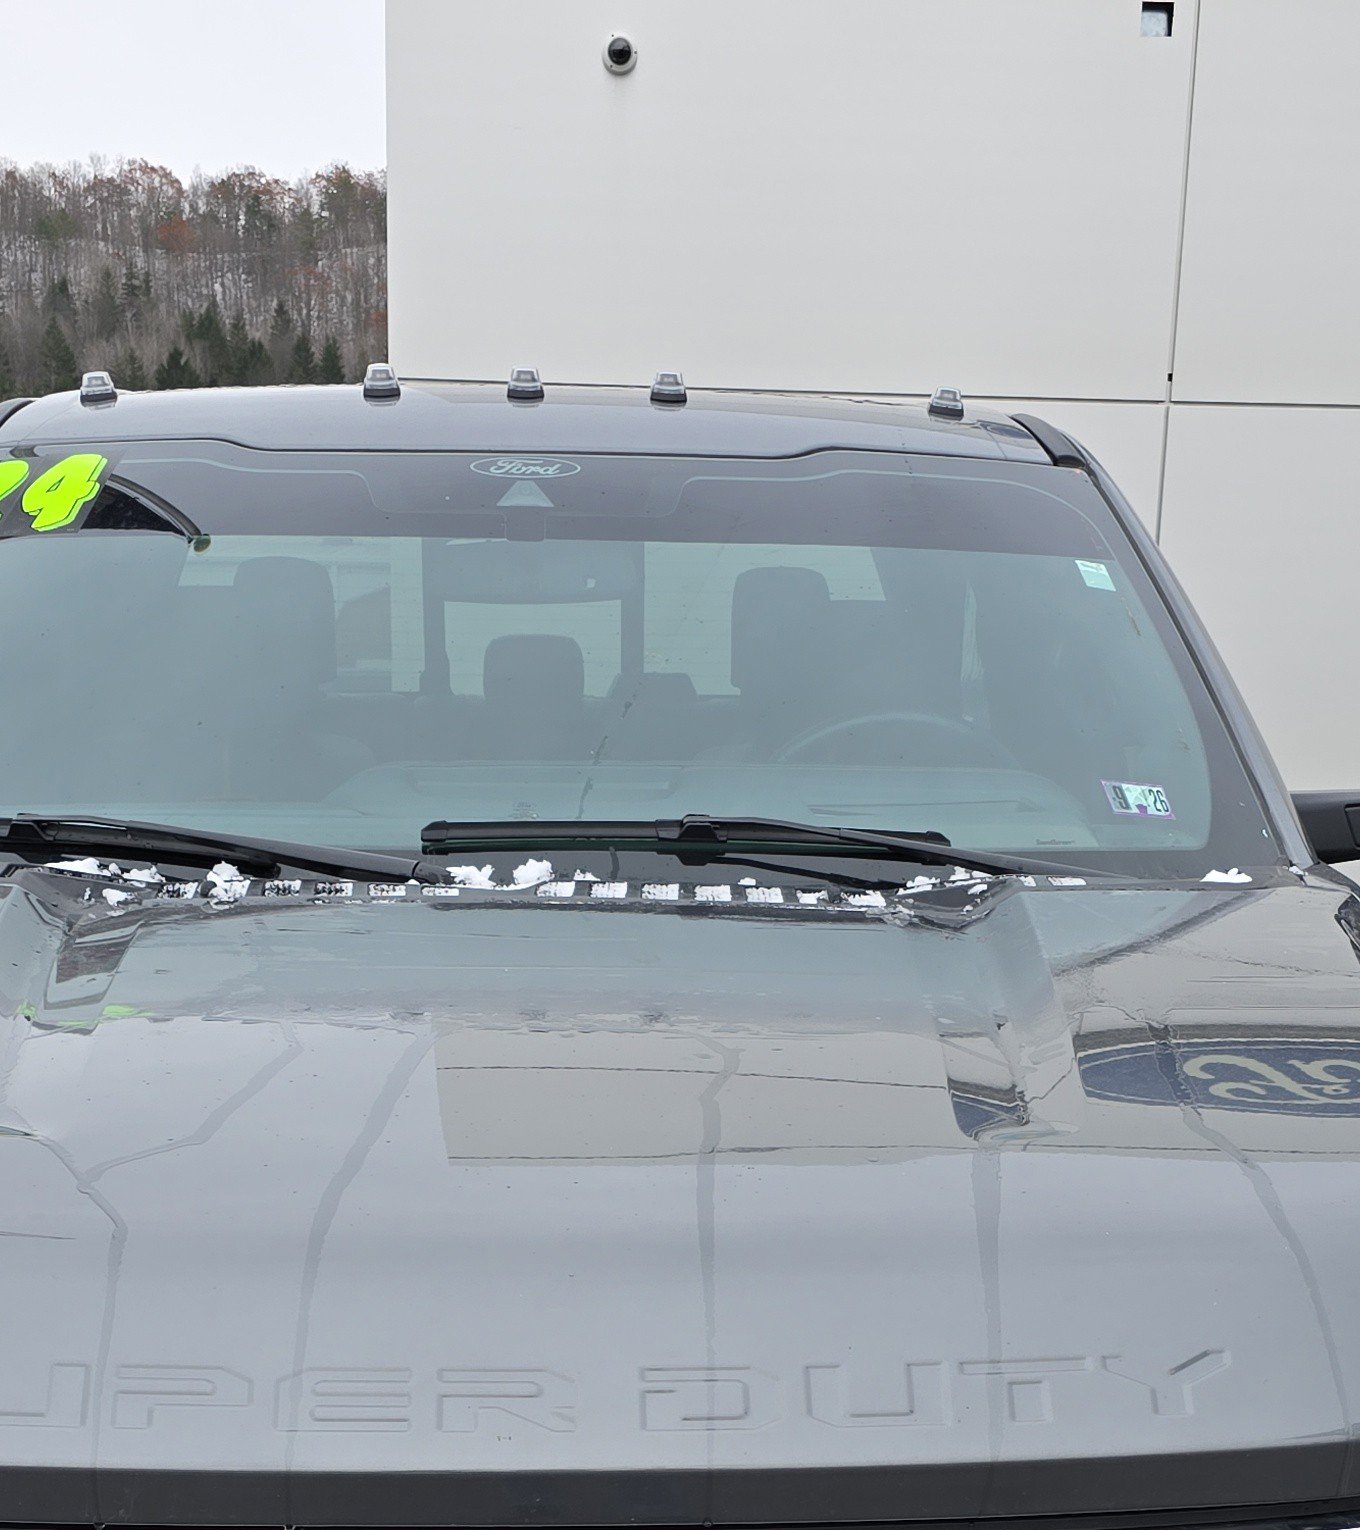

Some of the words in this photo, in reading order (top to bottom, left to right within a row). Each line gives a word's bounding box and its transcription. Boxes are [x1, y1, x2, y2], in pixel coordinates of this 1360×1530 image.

[490, 460, 562, 475] Ford
[1148, 789, 1169, 812] 26
[638, 1349, 1232, 1432] DUTY
